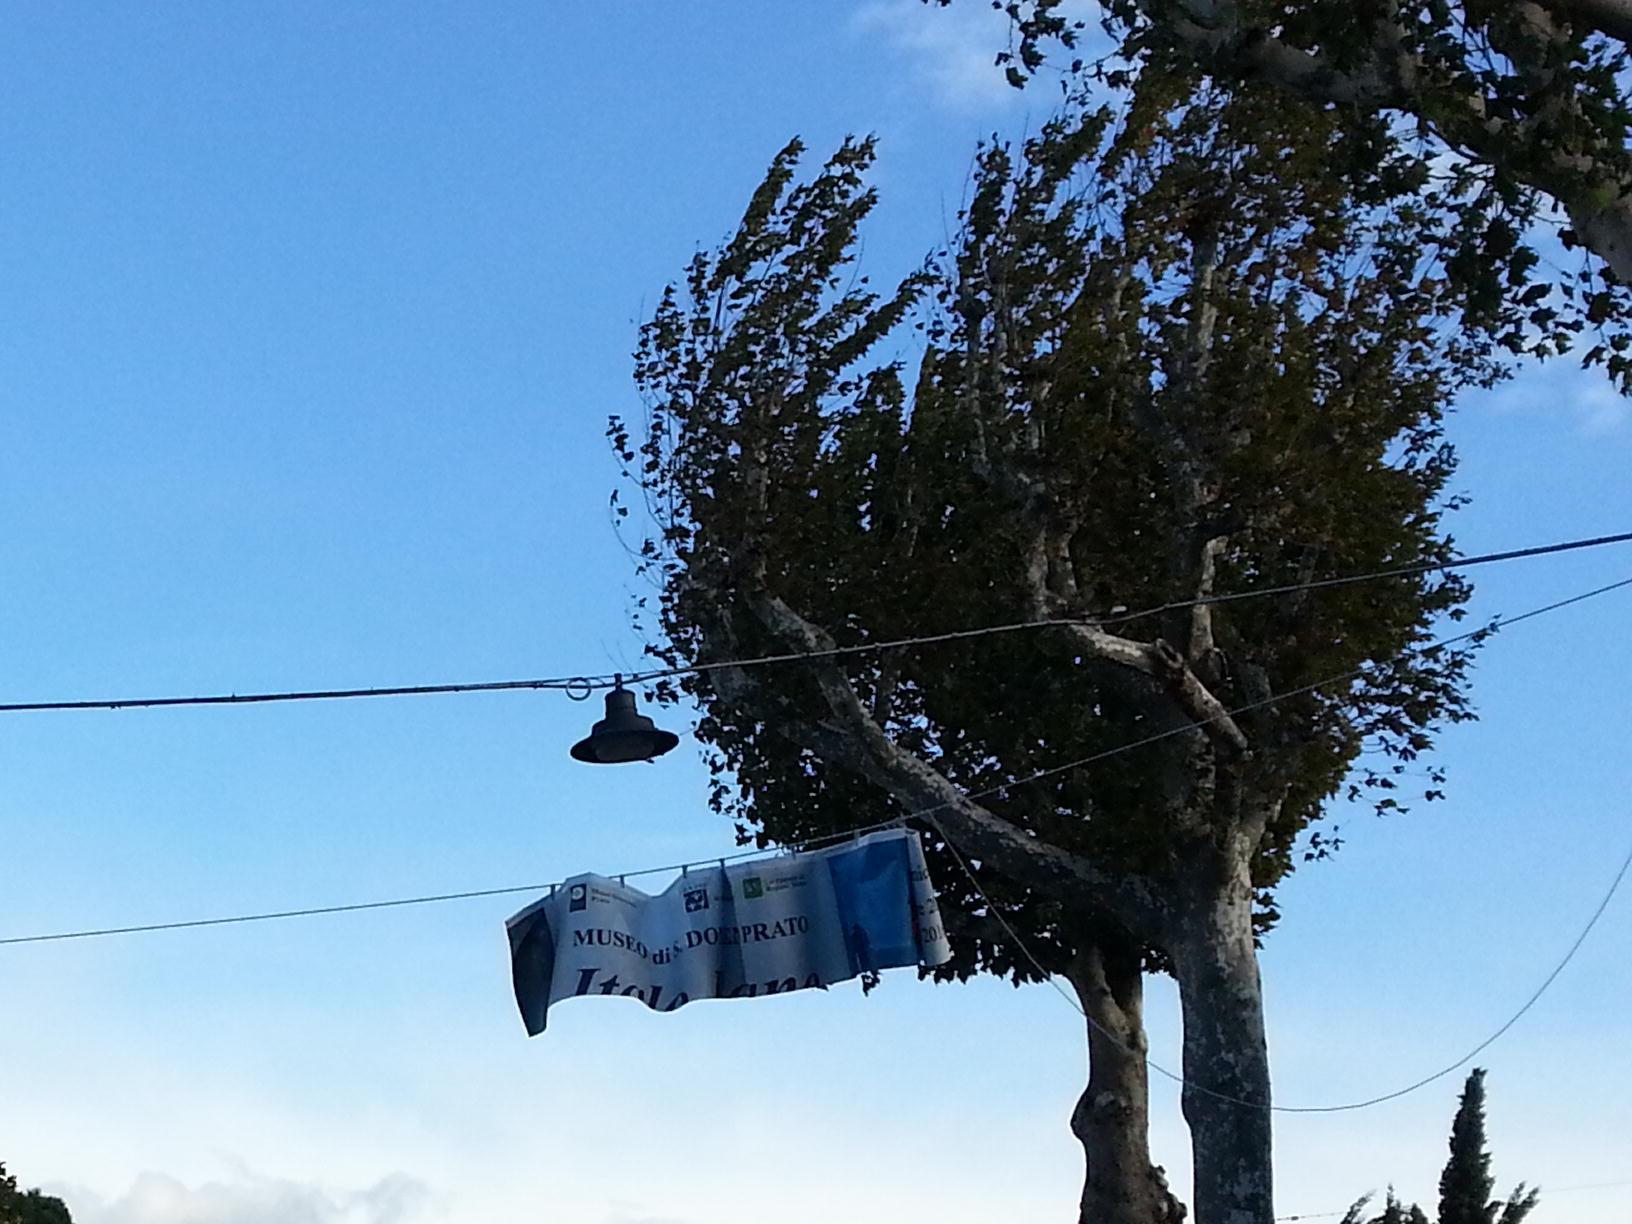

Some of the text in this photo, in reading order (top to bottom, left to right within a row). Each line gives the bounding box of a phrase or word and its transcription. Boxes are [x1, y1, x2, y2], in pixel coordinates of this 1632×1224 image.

[573, 928, 647, 960] MUSEO
[652, 947, 671, 965] di
[742, 915, 809, 944] PRATO
